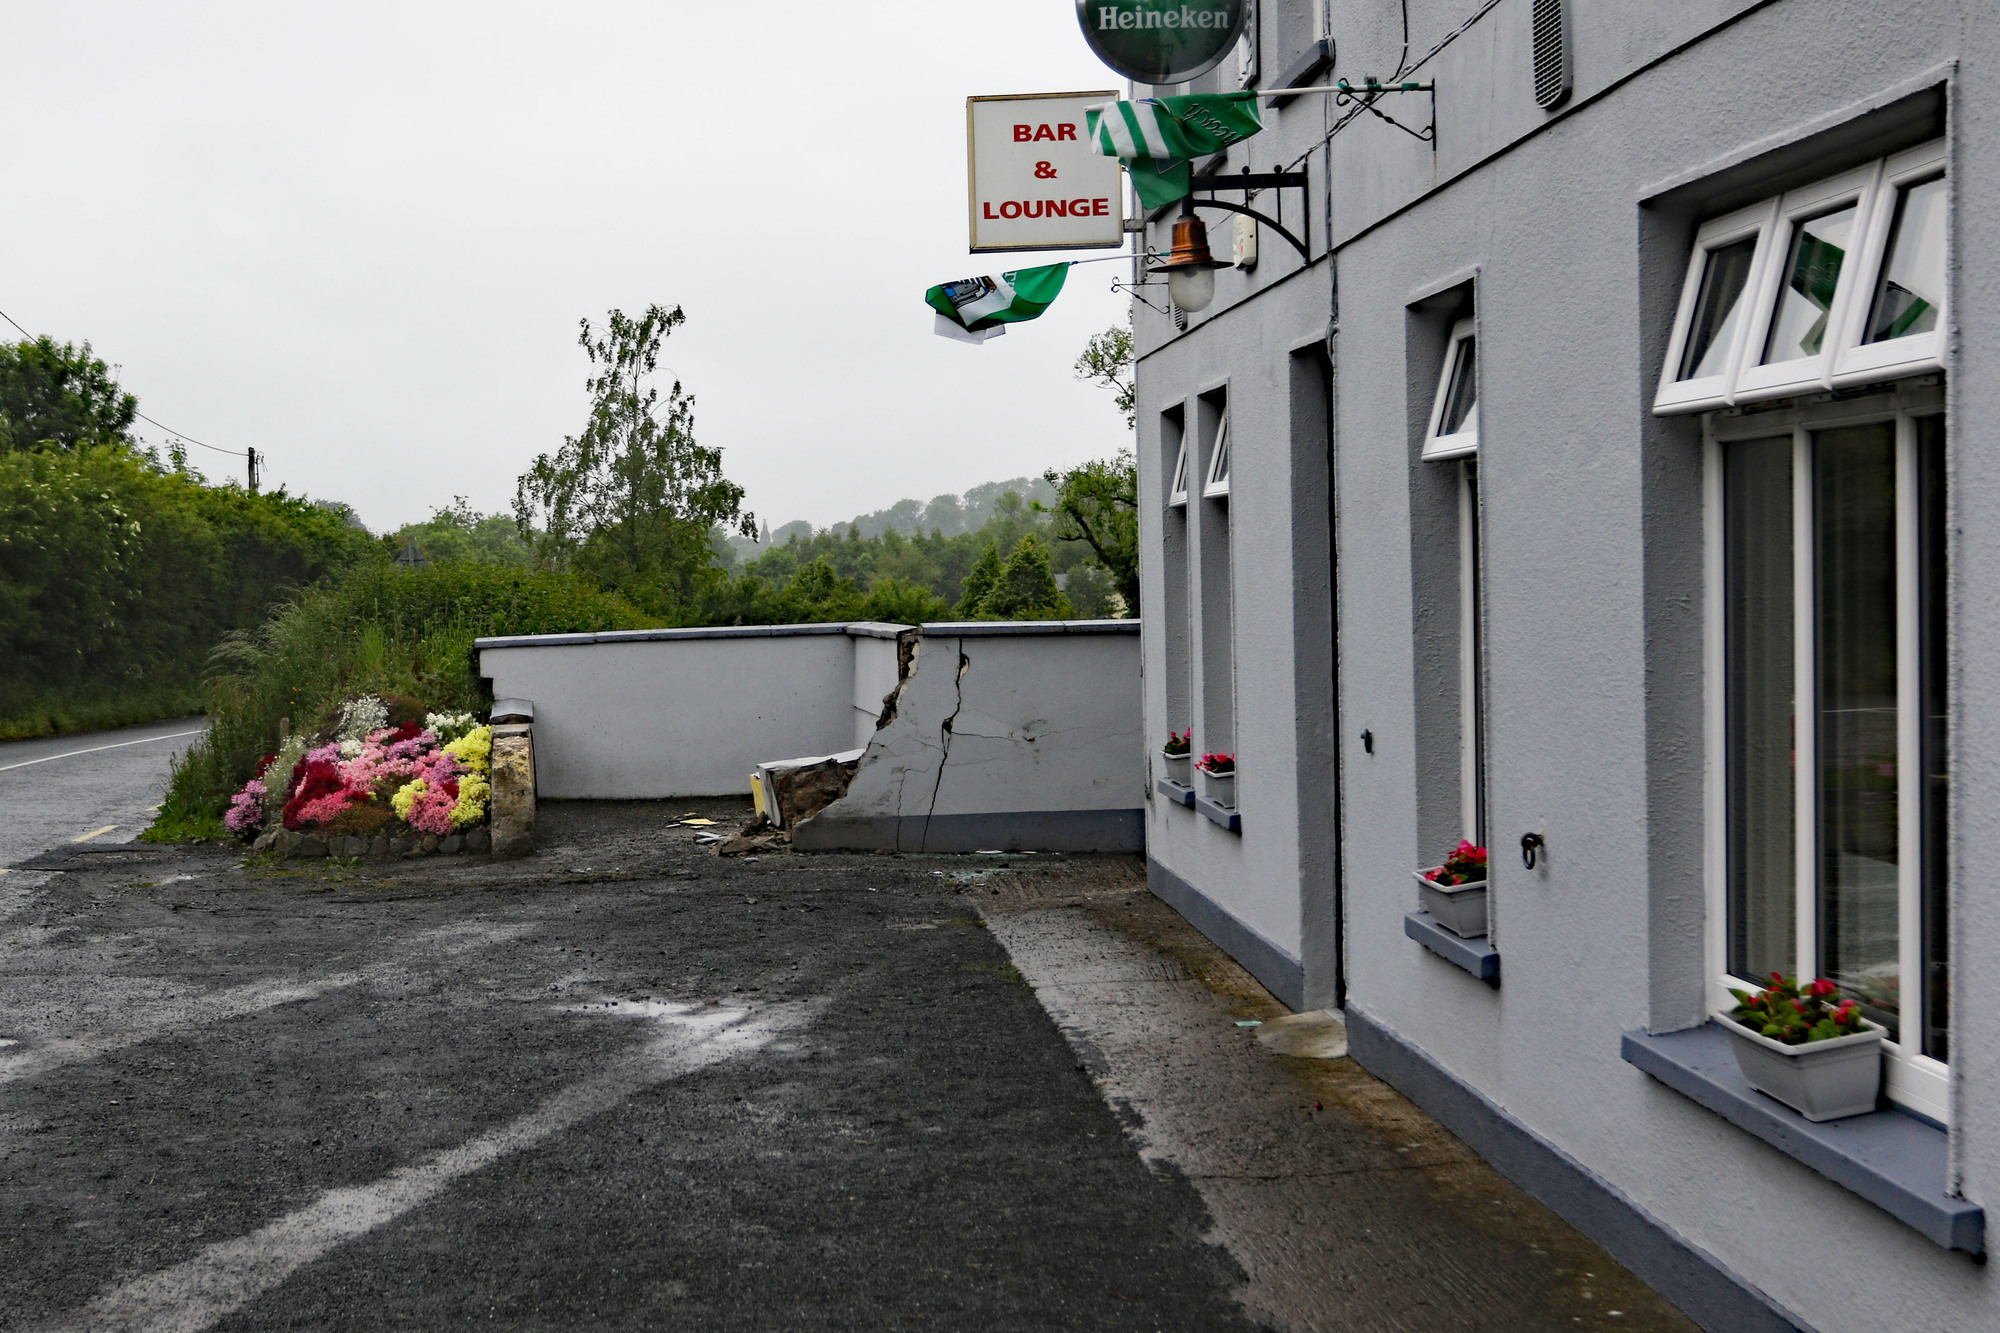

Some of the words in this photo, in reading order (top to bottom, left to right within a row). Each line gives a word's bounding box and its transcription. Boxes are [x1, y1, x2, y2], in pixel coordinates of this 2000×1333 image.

[1098, 5, 1229, 30] Heineken
[1013, 123, 1077, 142] BAR
[1034, 161, 1058, 179] &
[983, 198, 1109, 219] LOUNGE
